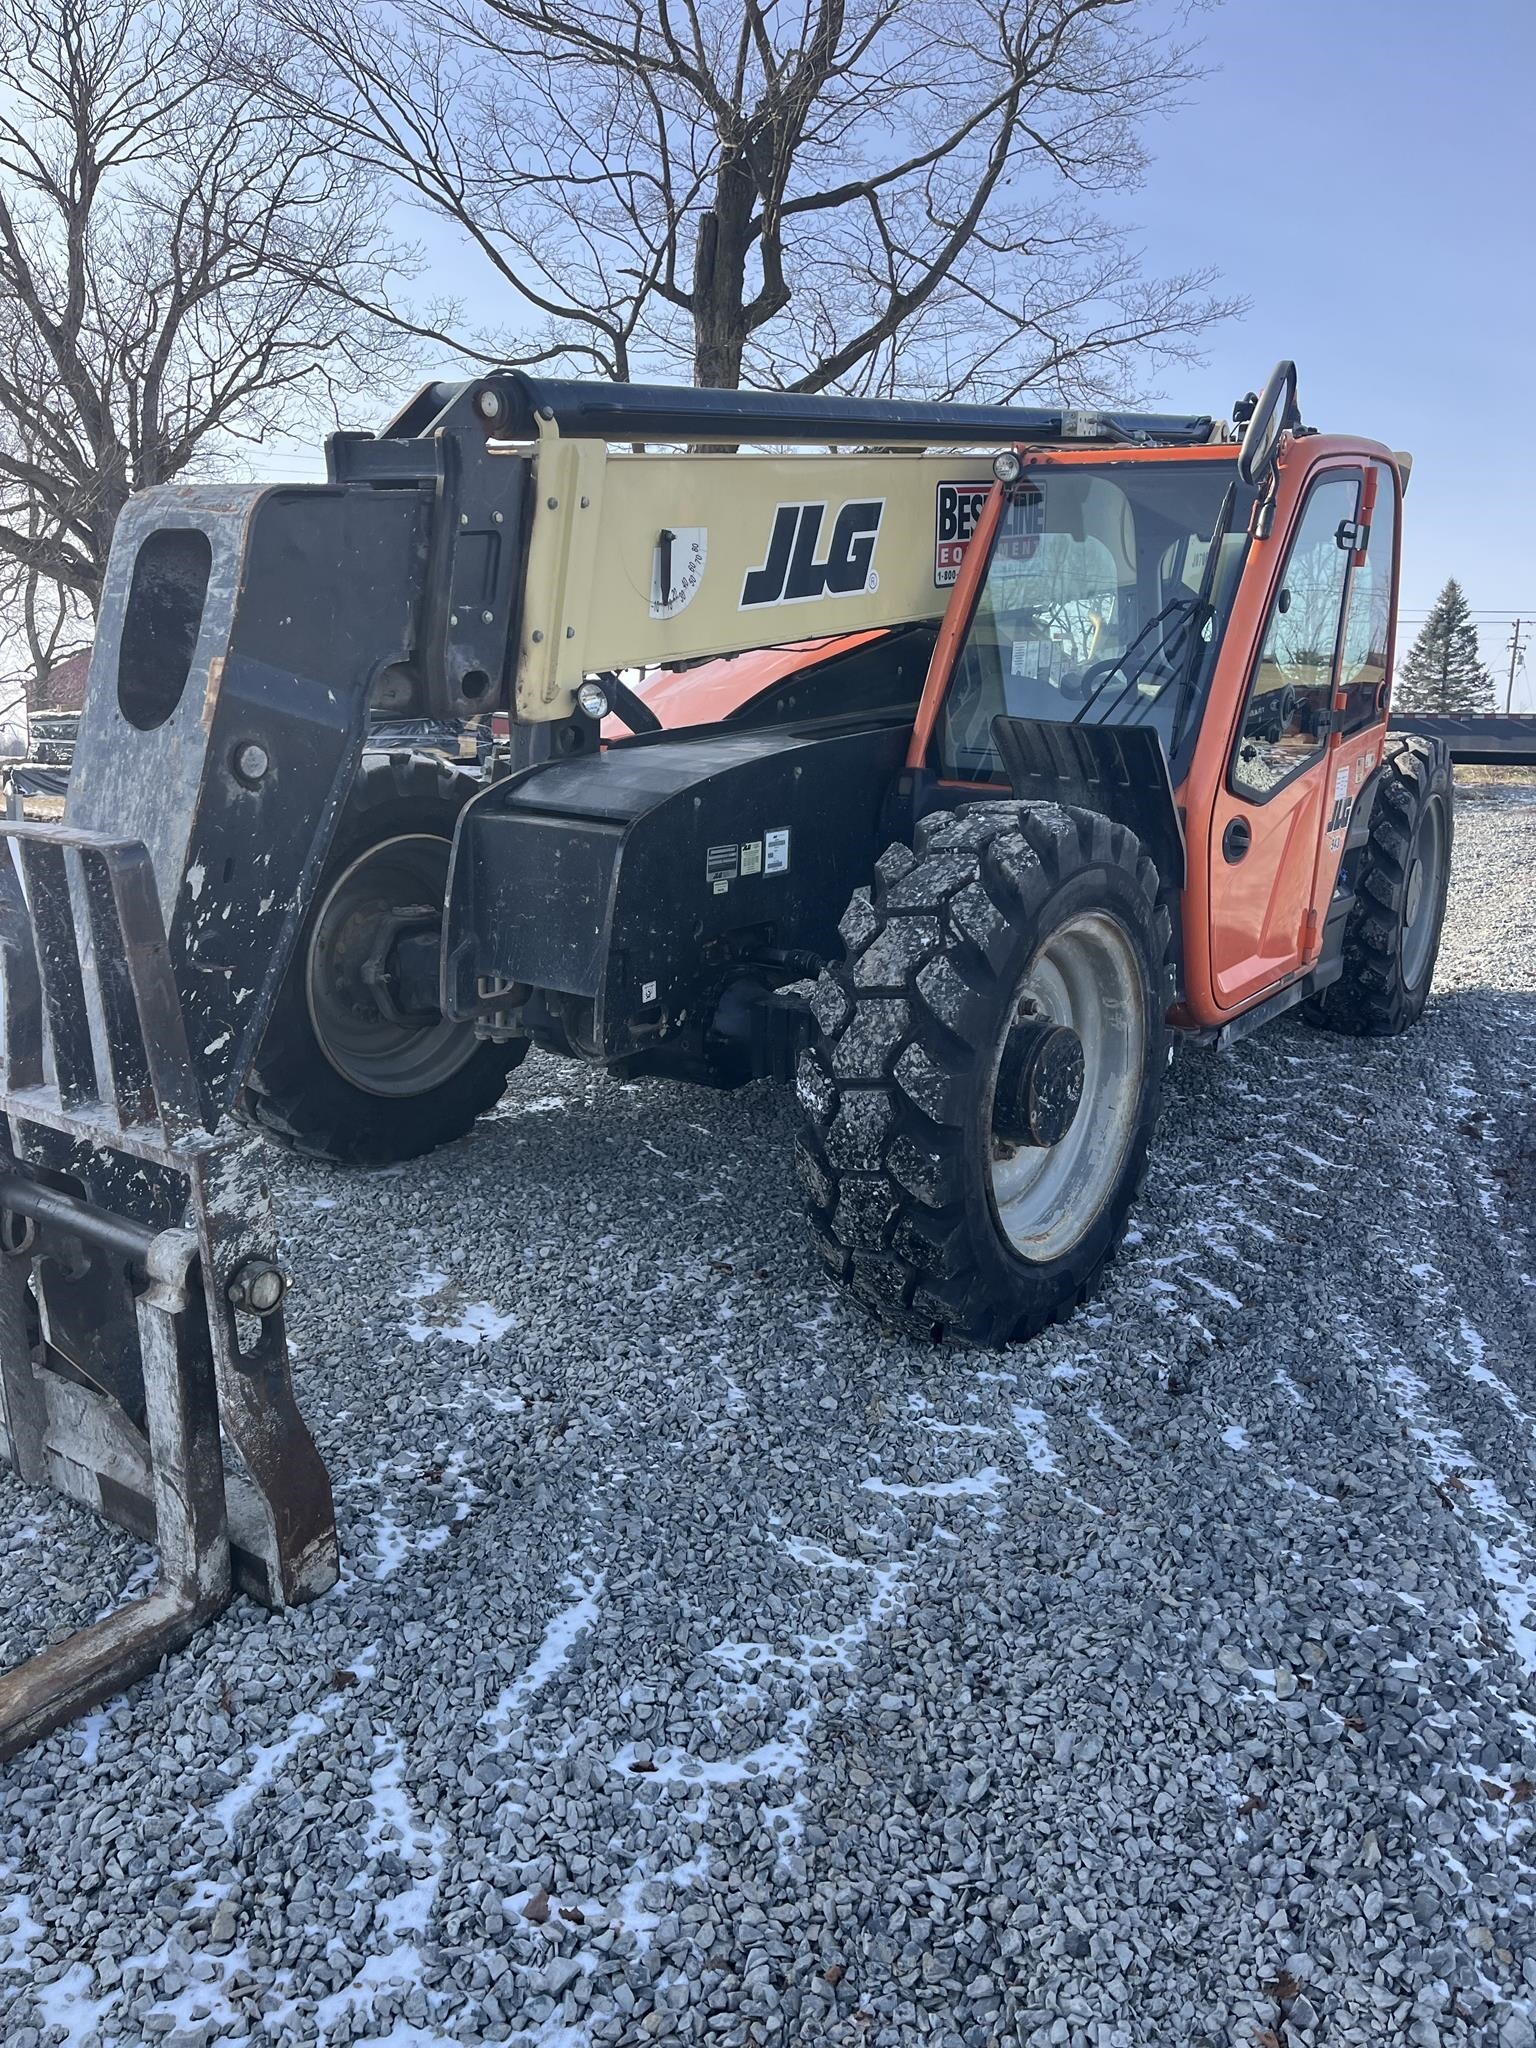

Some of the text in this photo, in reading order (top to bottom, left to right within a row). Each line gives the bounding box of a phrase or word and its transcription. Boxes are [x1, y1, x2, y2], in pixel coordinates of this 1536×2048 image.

[694, 554, 703, 565] 70
[741, 501, 883, 606] JLG
[688, 561, 696, 573] 60
[688, 575, 697, 587] 50
